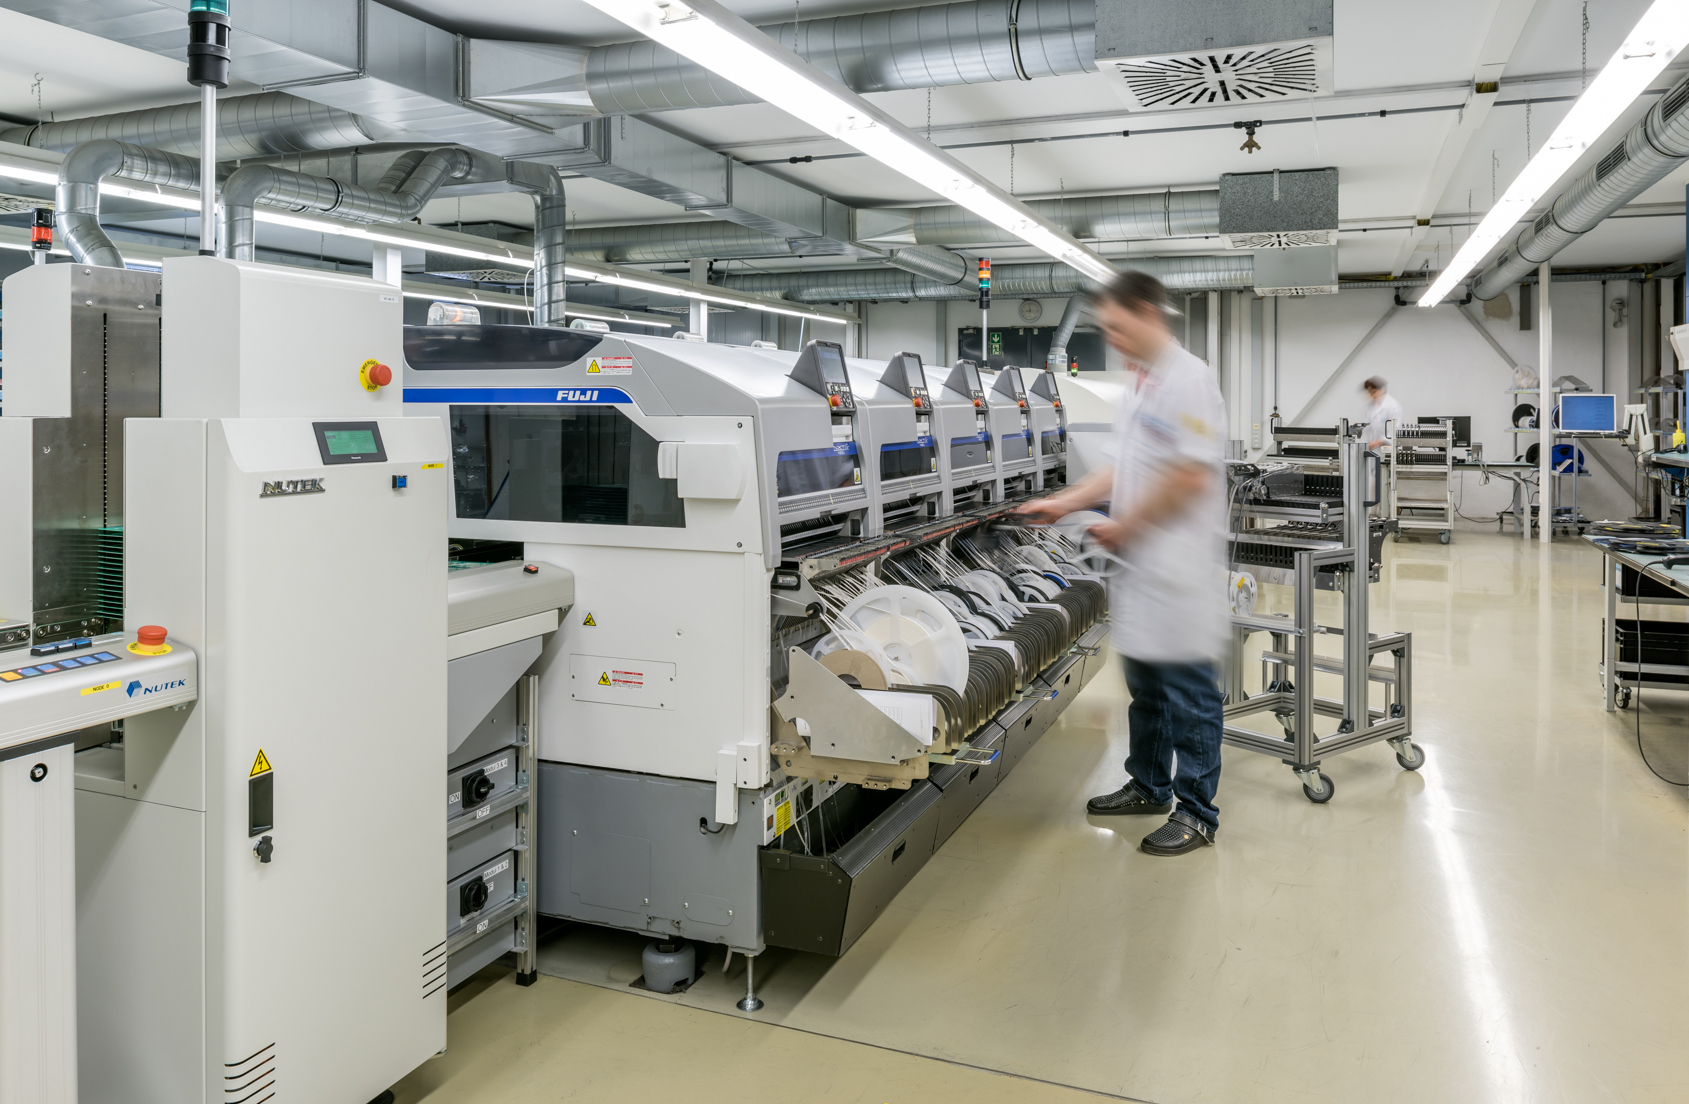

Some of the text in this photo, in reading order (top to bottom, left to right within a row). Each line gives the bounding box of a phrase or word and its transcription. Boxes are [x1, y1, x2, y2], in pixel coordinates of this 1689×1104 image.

[556, 390, 599, 401] FUJI
[260, 477, 325, 496] NUTEK
[92, 684, 105, 692] NODE
[143, 678, 187, 696] NUTEK
[449, 792, 460, 803] ON
[477, 806, 490, 817] OFF
[484, 868, 497, 878] Modul
[477, 920, 488, 932] ON
